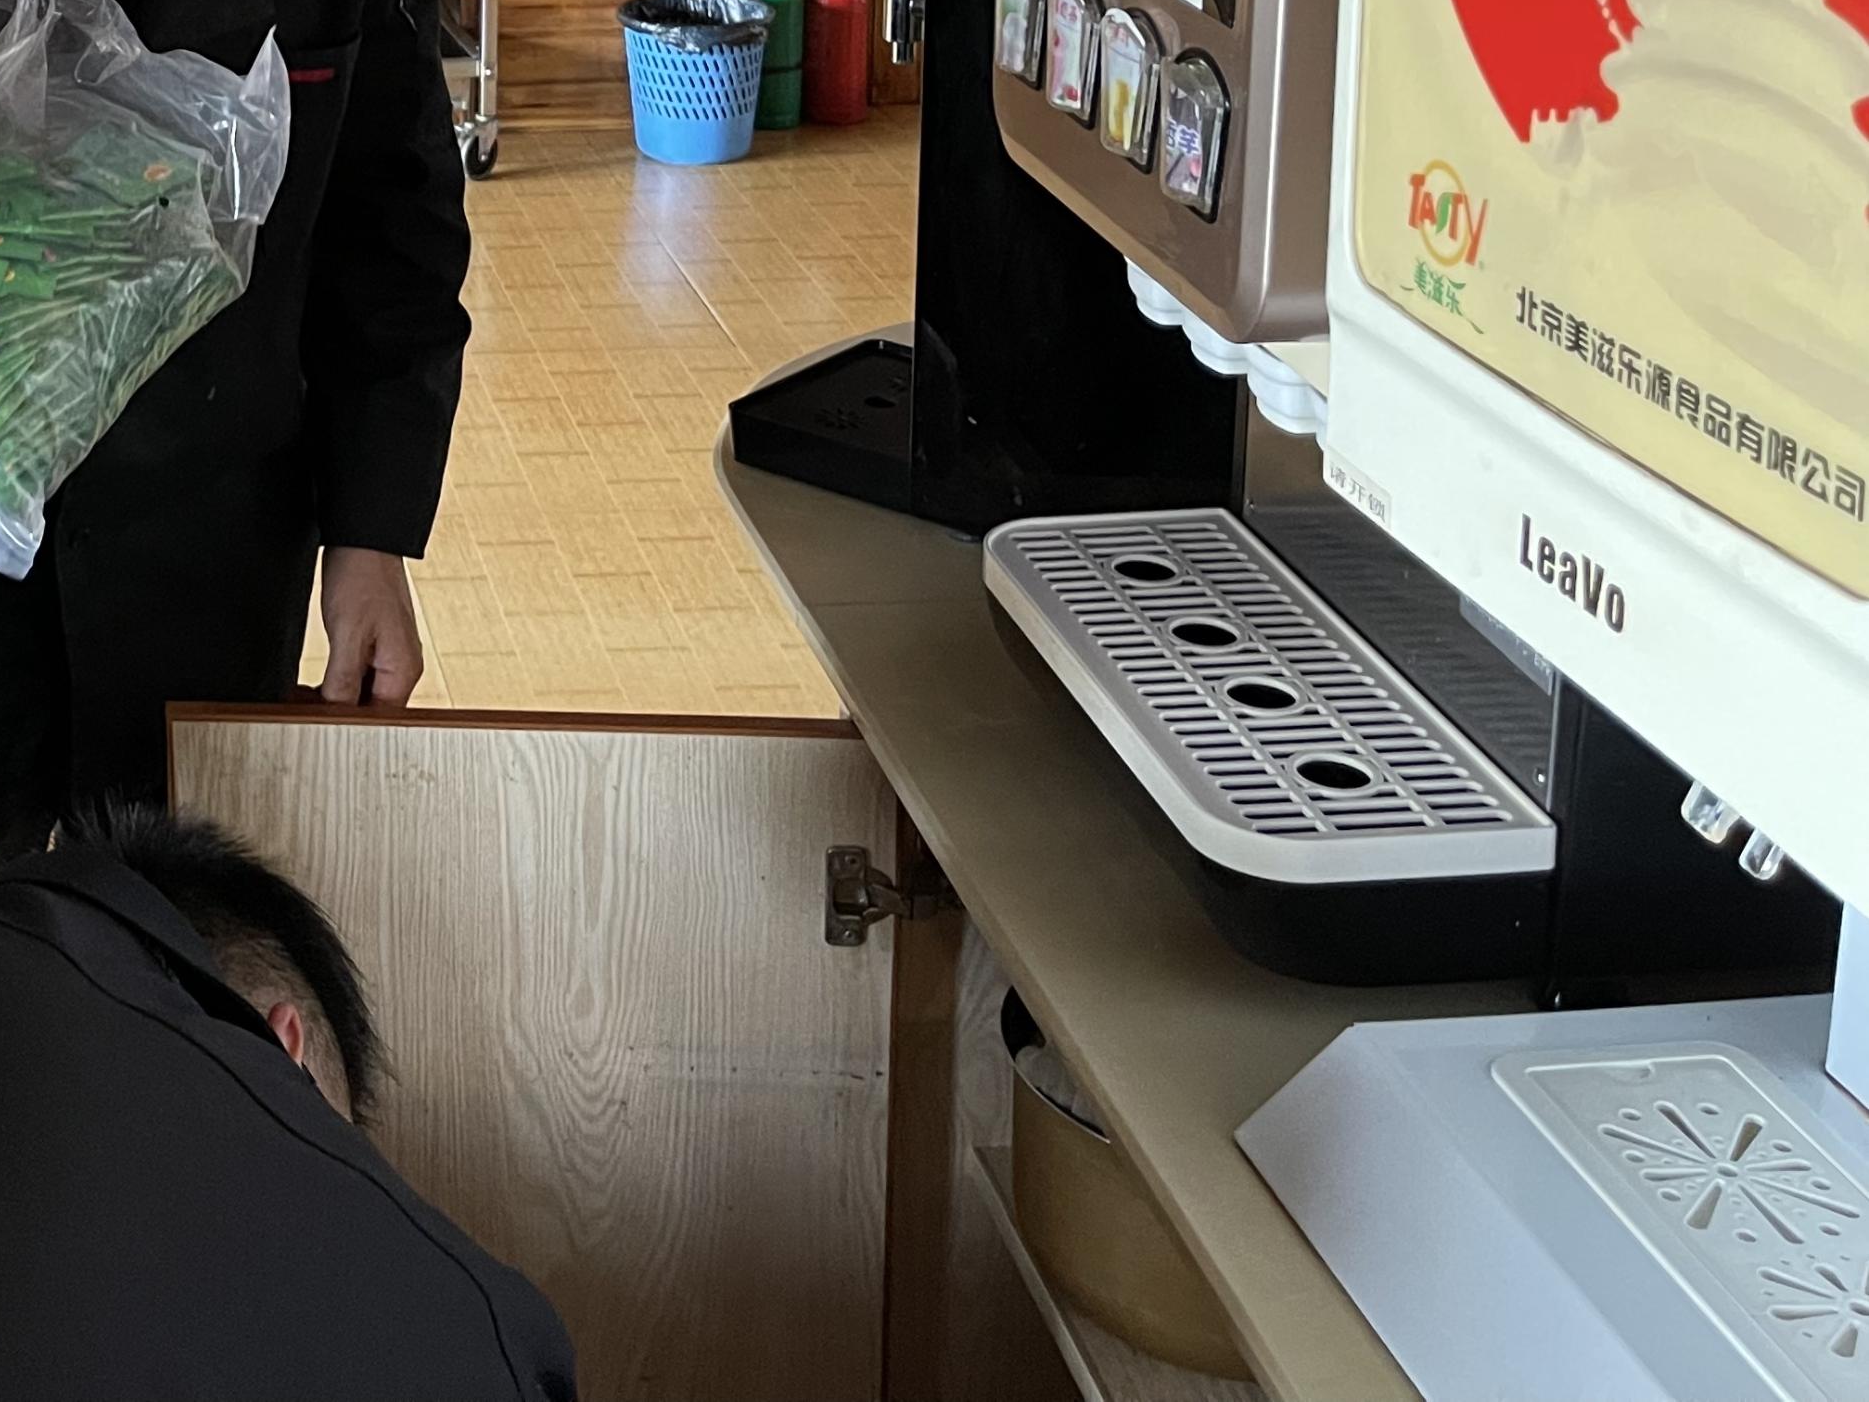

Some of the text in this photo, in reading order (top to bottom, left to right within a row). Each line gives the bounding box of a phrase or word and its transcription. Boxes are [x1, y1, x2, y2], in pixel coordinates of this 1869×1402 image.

[1408, 173, 1488, 267] TASTY
[1408, 258, 1475, 324] 美滋乐
[1515, 285, 1867, 523] 北京美滋乐源食品有限公司
[1520, 512, 1626, 634] LeaVo
